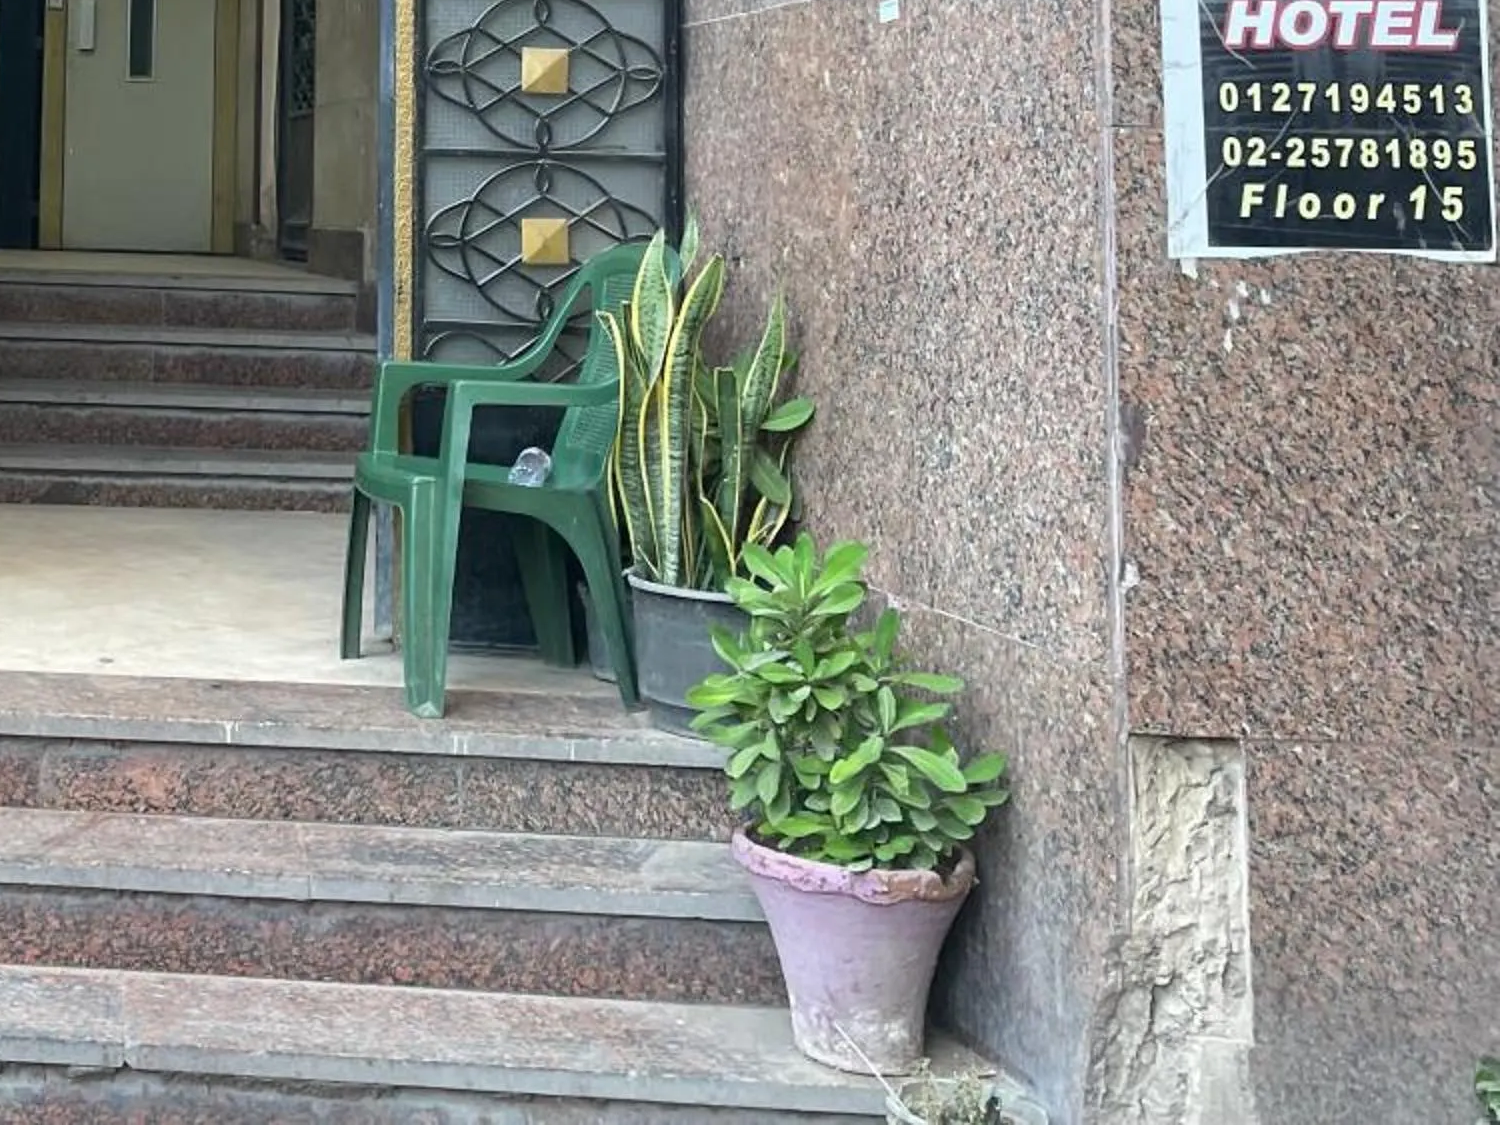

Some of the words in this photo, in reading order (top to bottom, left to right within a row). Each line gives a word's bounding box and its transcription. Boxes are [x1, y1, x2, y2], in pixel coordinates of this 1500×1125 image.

[1219, 82, 1473, 114] 0127194513
[1223, 136, 1477, 170] 02-25781895
[1239, 183, 1385, 220] Floor
[1409, 184, 1465, 221] 15
